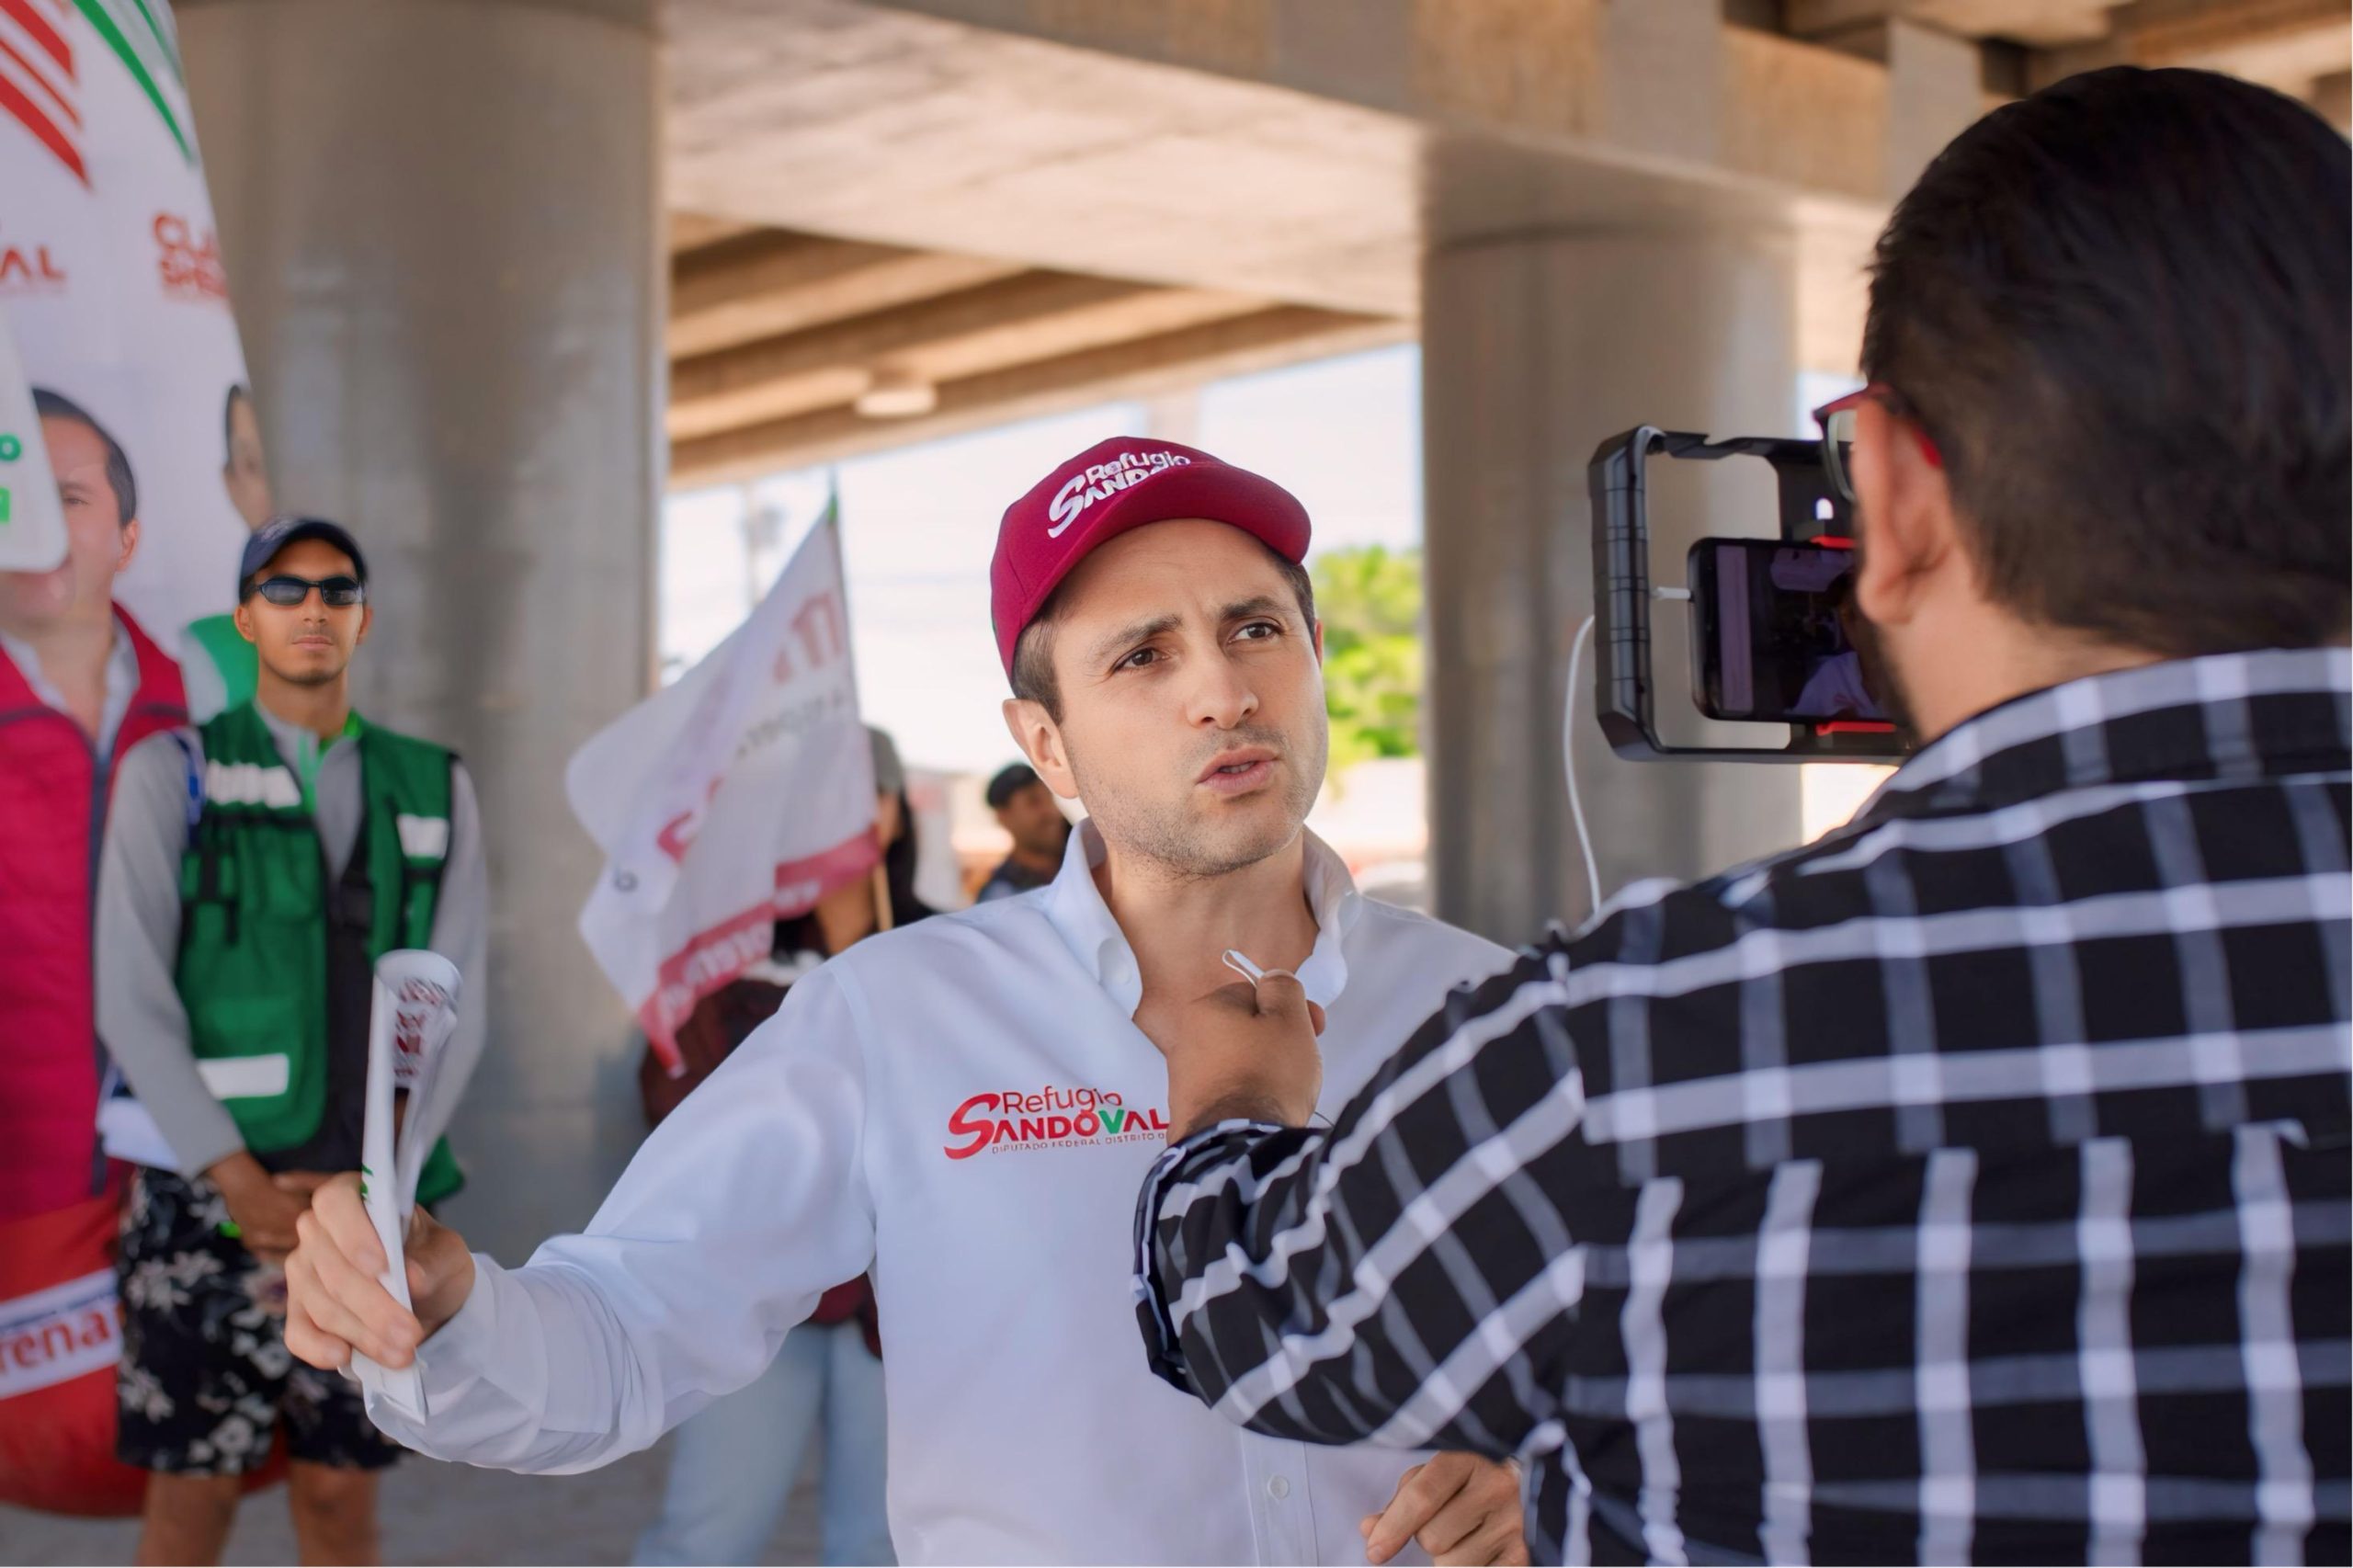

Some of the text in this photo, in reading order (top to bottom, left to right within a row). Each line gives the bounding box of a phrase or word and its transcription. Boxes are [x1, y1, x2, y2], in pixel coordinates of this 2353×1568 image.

[1085, 449, 1191, 485] Refugio
[1002, 1085, 1123, 1114] Refugio
[943, 1093, 1170, 1160] SANDOVAL
[992, 1142, 1049, 1154] DIPUTADO
[1051, 1139, 1101, 1149] FEDERAL
[1105, 1132, 1155, 1144] DISTRITO
